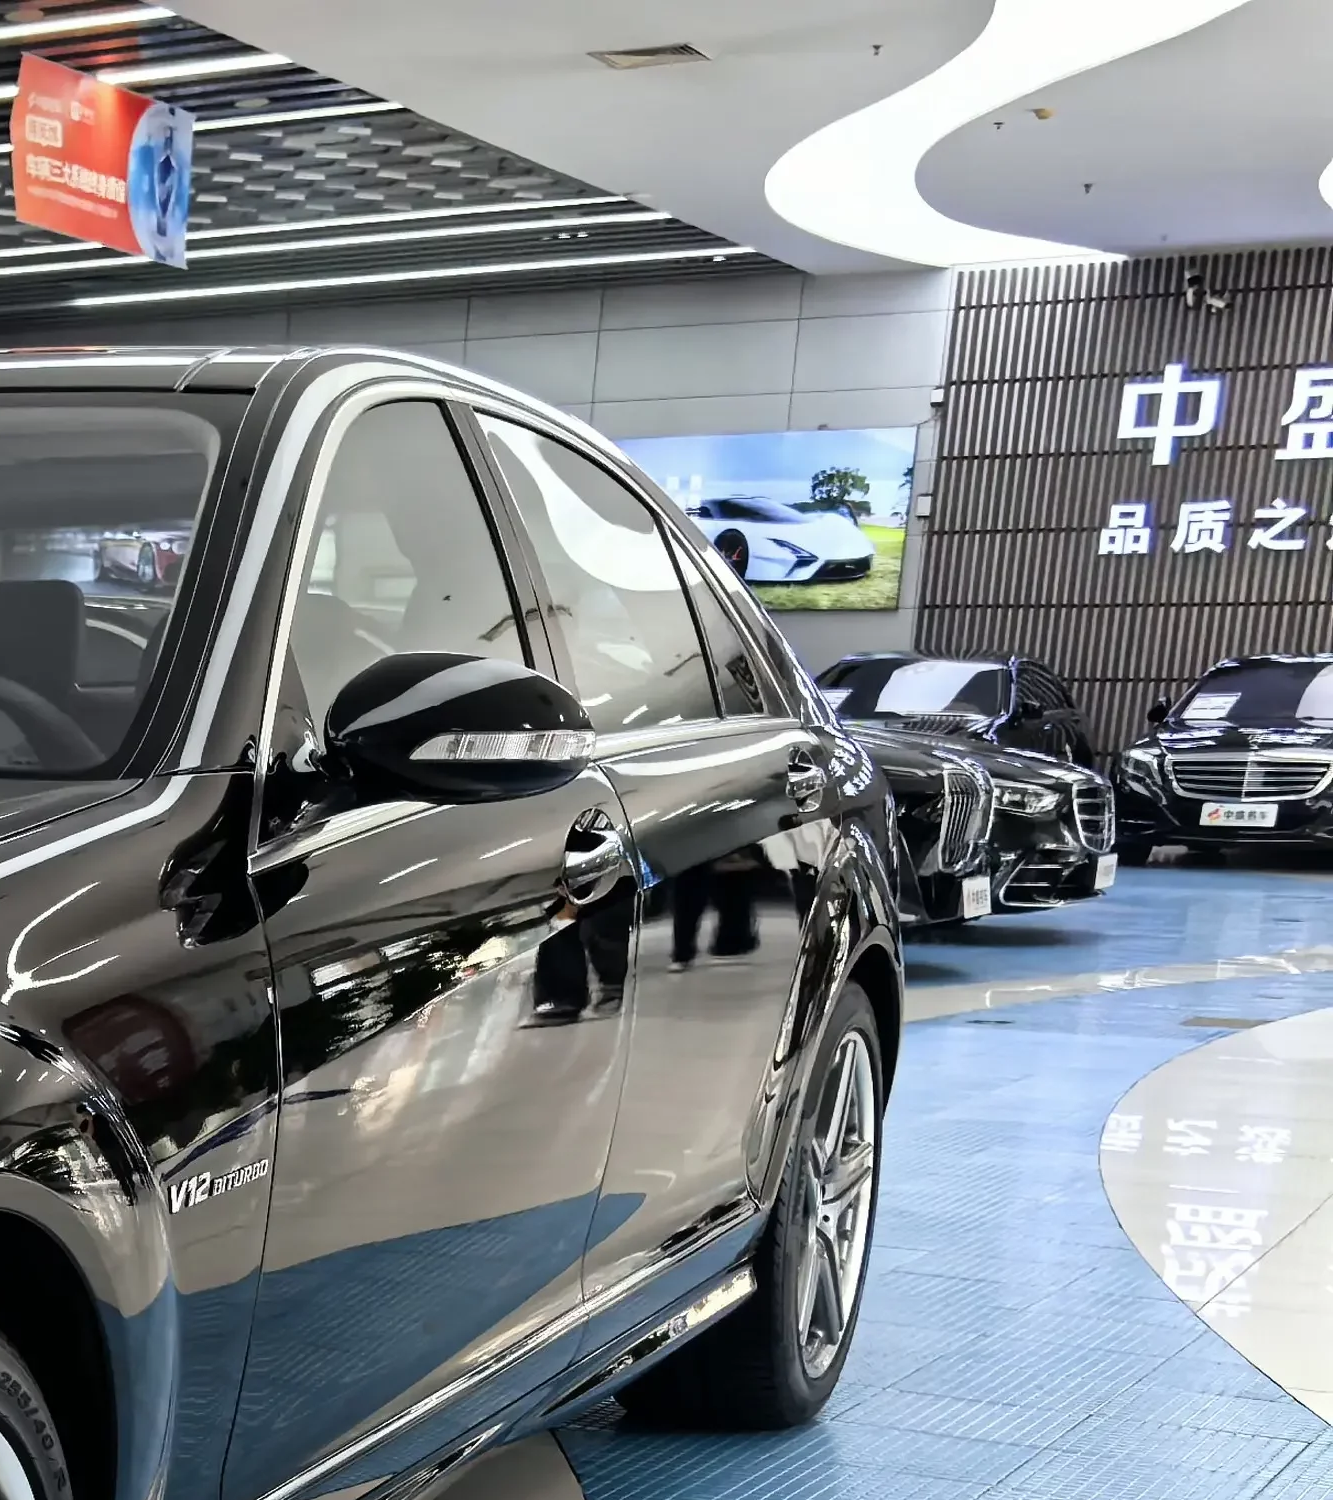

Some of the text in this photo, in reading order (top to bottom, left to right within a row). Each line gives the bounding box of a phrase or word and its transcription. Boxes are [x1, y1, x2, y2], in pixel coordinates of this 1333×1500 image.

[1097, 497, 1333, 555] 品质之
[169, 1171, 211, 1214] V12
